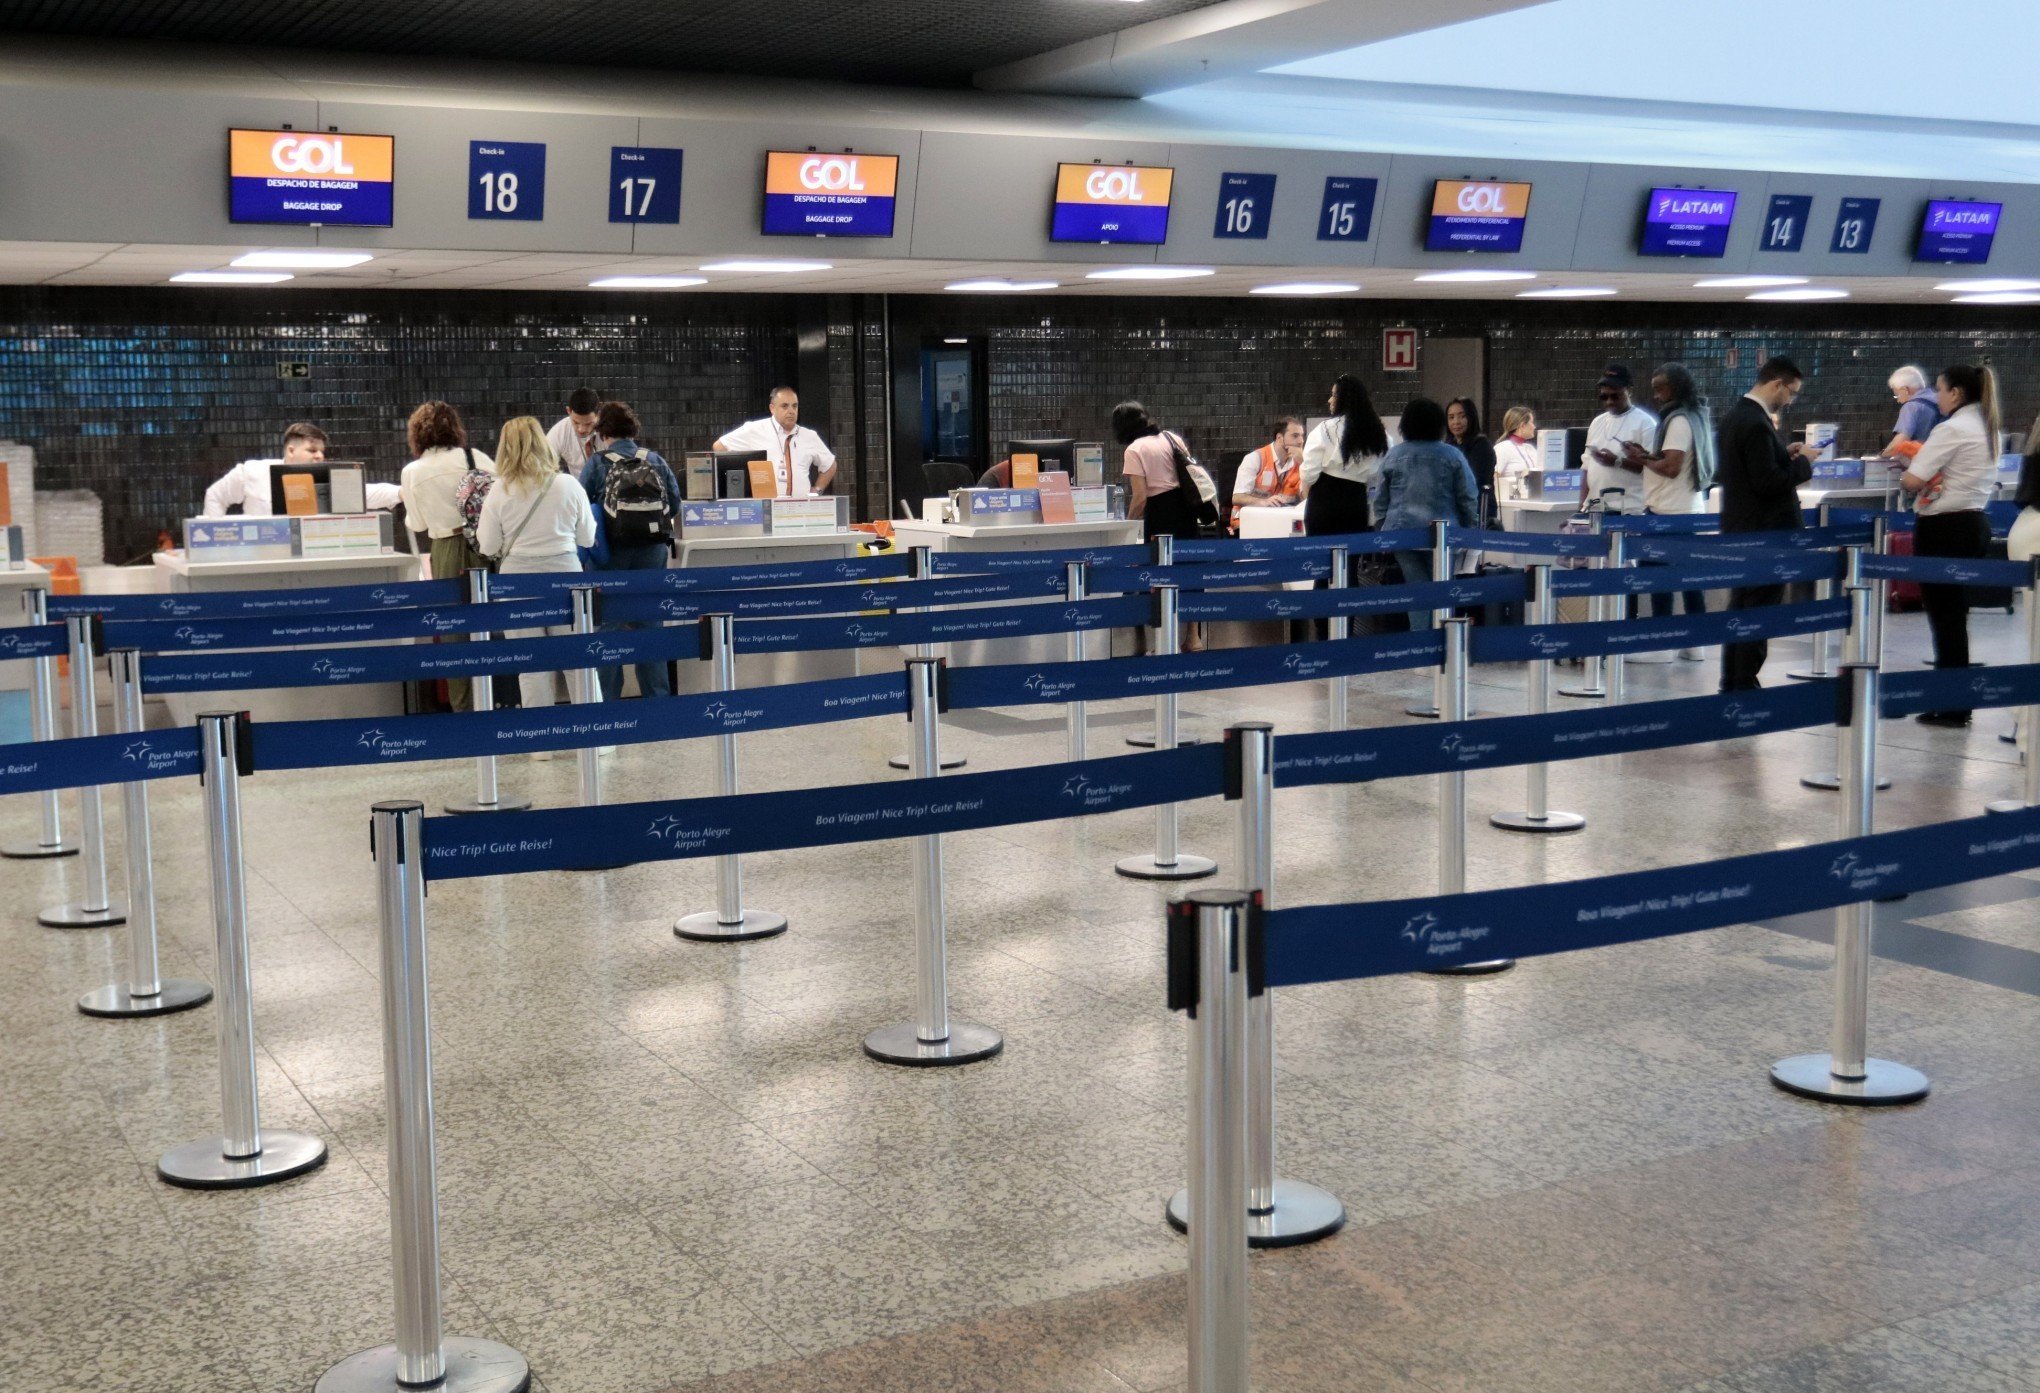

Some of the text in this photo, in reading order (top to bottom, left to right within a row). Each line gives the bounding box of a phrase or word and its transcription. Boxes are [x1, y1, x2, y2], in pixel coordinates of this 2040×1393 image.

[272, 138, 353, 174] GOL
[800, 160, 864, 190] GOL
[267, 179, 308, 189] DESPACHO
[321, 181, 358, 190] BAGAGEM
[1086, 171, 1142, 200] GOL
[479, 173, 518, 212] 18
[620, 178, 656, 216] 17
[1458, 186, 1504, 212] GOL
[794, 195, 826, 203] DESPACHO
[837, 196, 867, 204] BAGAGEM
[284, 202, 342, 211] BAGGAGE DROP
[1671, 201, 1723, 214] LATAM
[1225, 199, 1253, 233] 16
[1329, 203, 1355, 235] 15
[1945, 212, 1990, 224] LATAM
[1770, 218, 1792, 246] 14
[1840, 220, 1860, 248] 13
[1142, 673, 1167, 683] Viagem!
[1169, 672, 1183, 680] Nice
[1184, 671, 1198, 680] Trip!
[1200, 670, 1214, 678] Gute
[1215, 668, 1233, 676] Reise!
[1057, 682, 1076, 690] Alegre
[824, 690, 906, 707] Boa Viagem! Nice Trip!
[1040, 689, 1061, 698] Airport
[742, 710, 764, 718] Alegre
[723, 718, 746, 727] Airport
[497, 720, 638, 739] Boa Viagem! Nice Trip! Gute Reise!
[381, 739, 427, 748] Porto Alegre
[149, 751, 198, 761] Porto Alegre
[380, 747, 407, 757] Airport
[8, 763, 37, 774] Reise!
[148, 759, 177, 770] Airport
[1085, 785, 1132, 796] Porto Alegre
[1084, 794, 1111, 806] Airport
[815, 800, 983, 825] Boa Viagem! Nice Trip! Gute Reise!
[675, 827, 731, 840] Porto Alegre
[431, 838, 552, 858] Nice Trip! Gute Reise!
[673, 837, 706, 850] Airport
